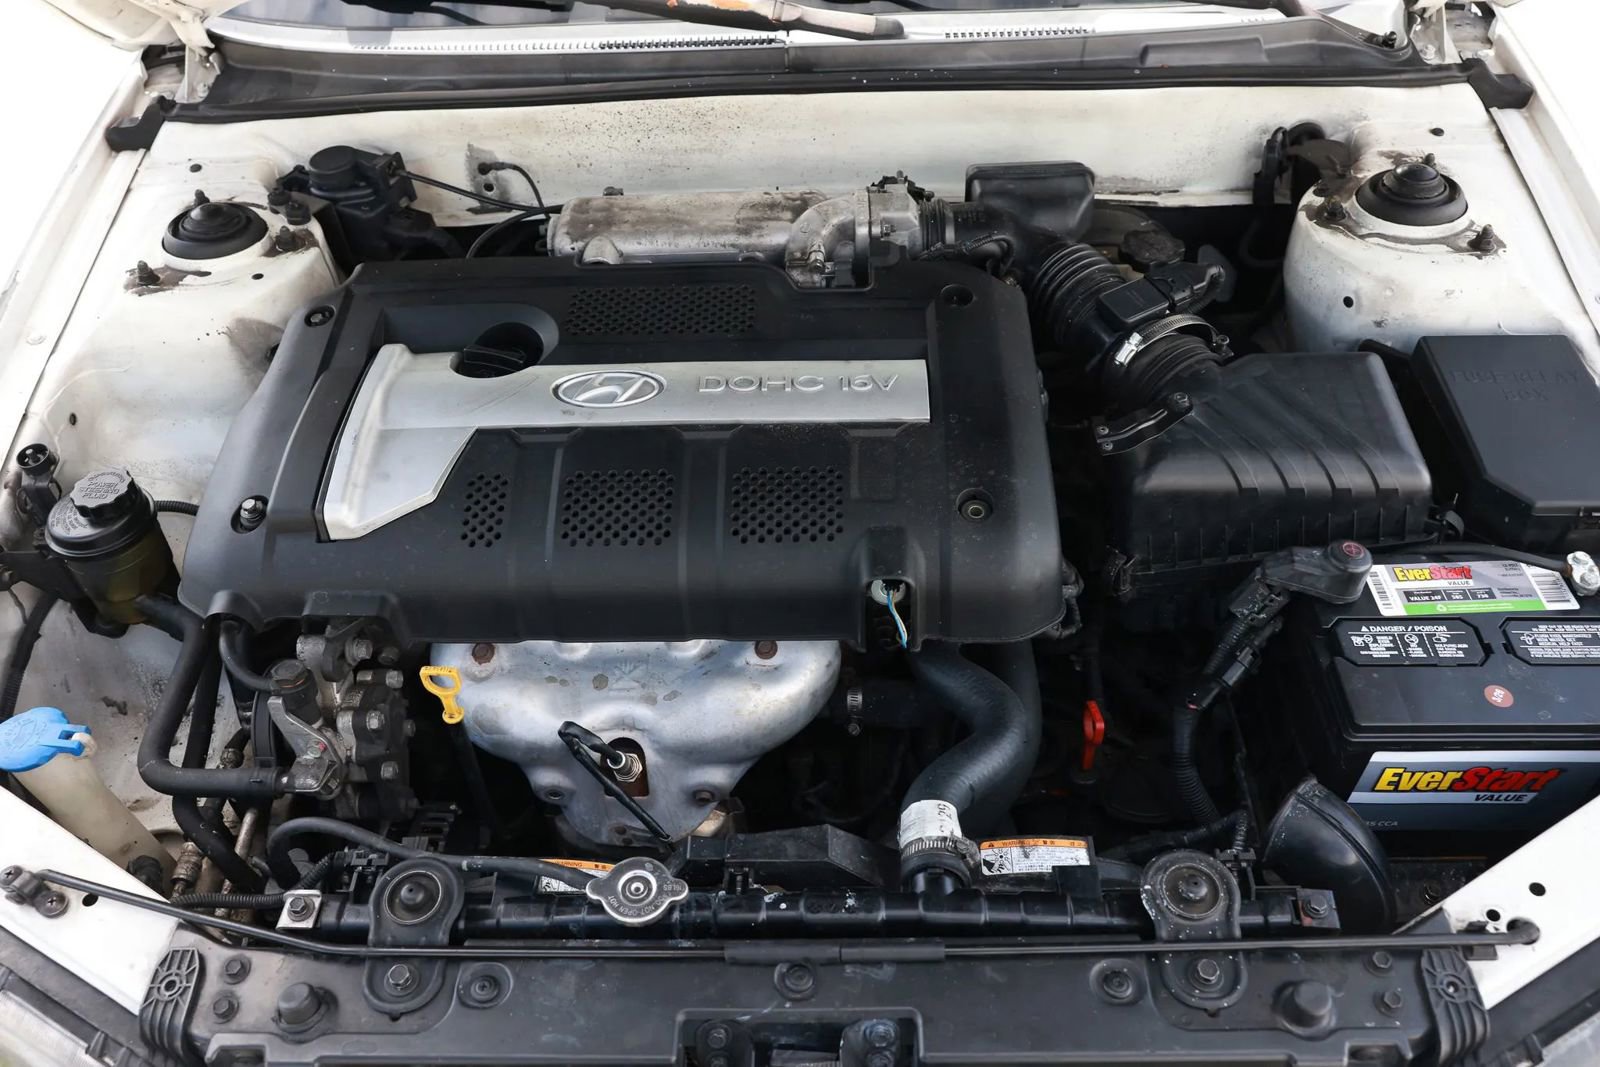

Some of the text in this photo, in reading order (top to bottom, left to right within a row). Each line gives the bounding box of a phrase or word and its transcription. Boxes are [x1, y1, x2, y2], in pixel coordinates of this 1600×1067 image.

[699, 374, 898, 392] DOHC 16V
[1393, 564, 1473, 581] EverStart
[1373, 765, 1562, 792] EverStart
[1473, 794, 1528, 802] VALUE
[607, 895, 619, 908] HOT
[619, 906, 638, 917] OPEN
